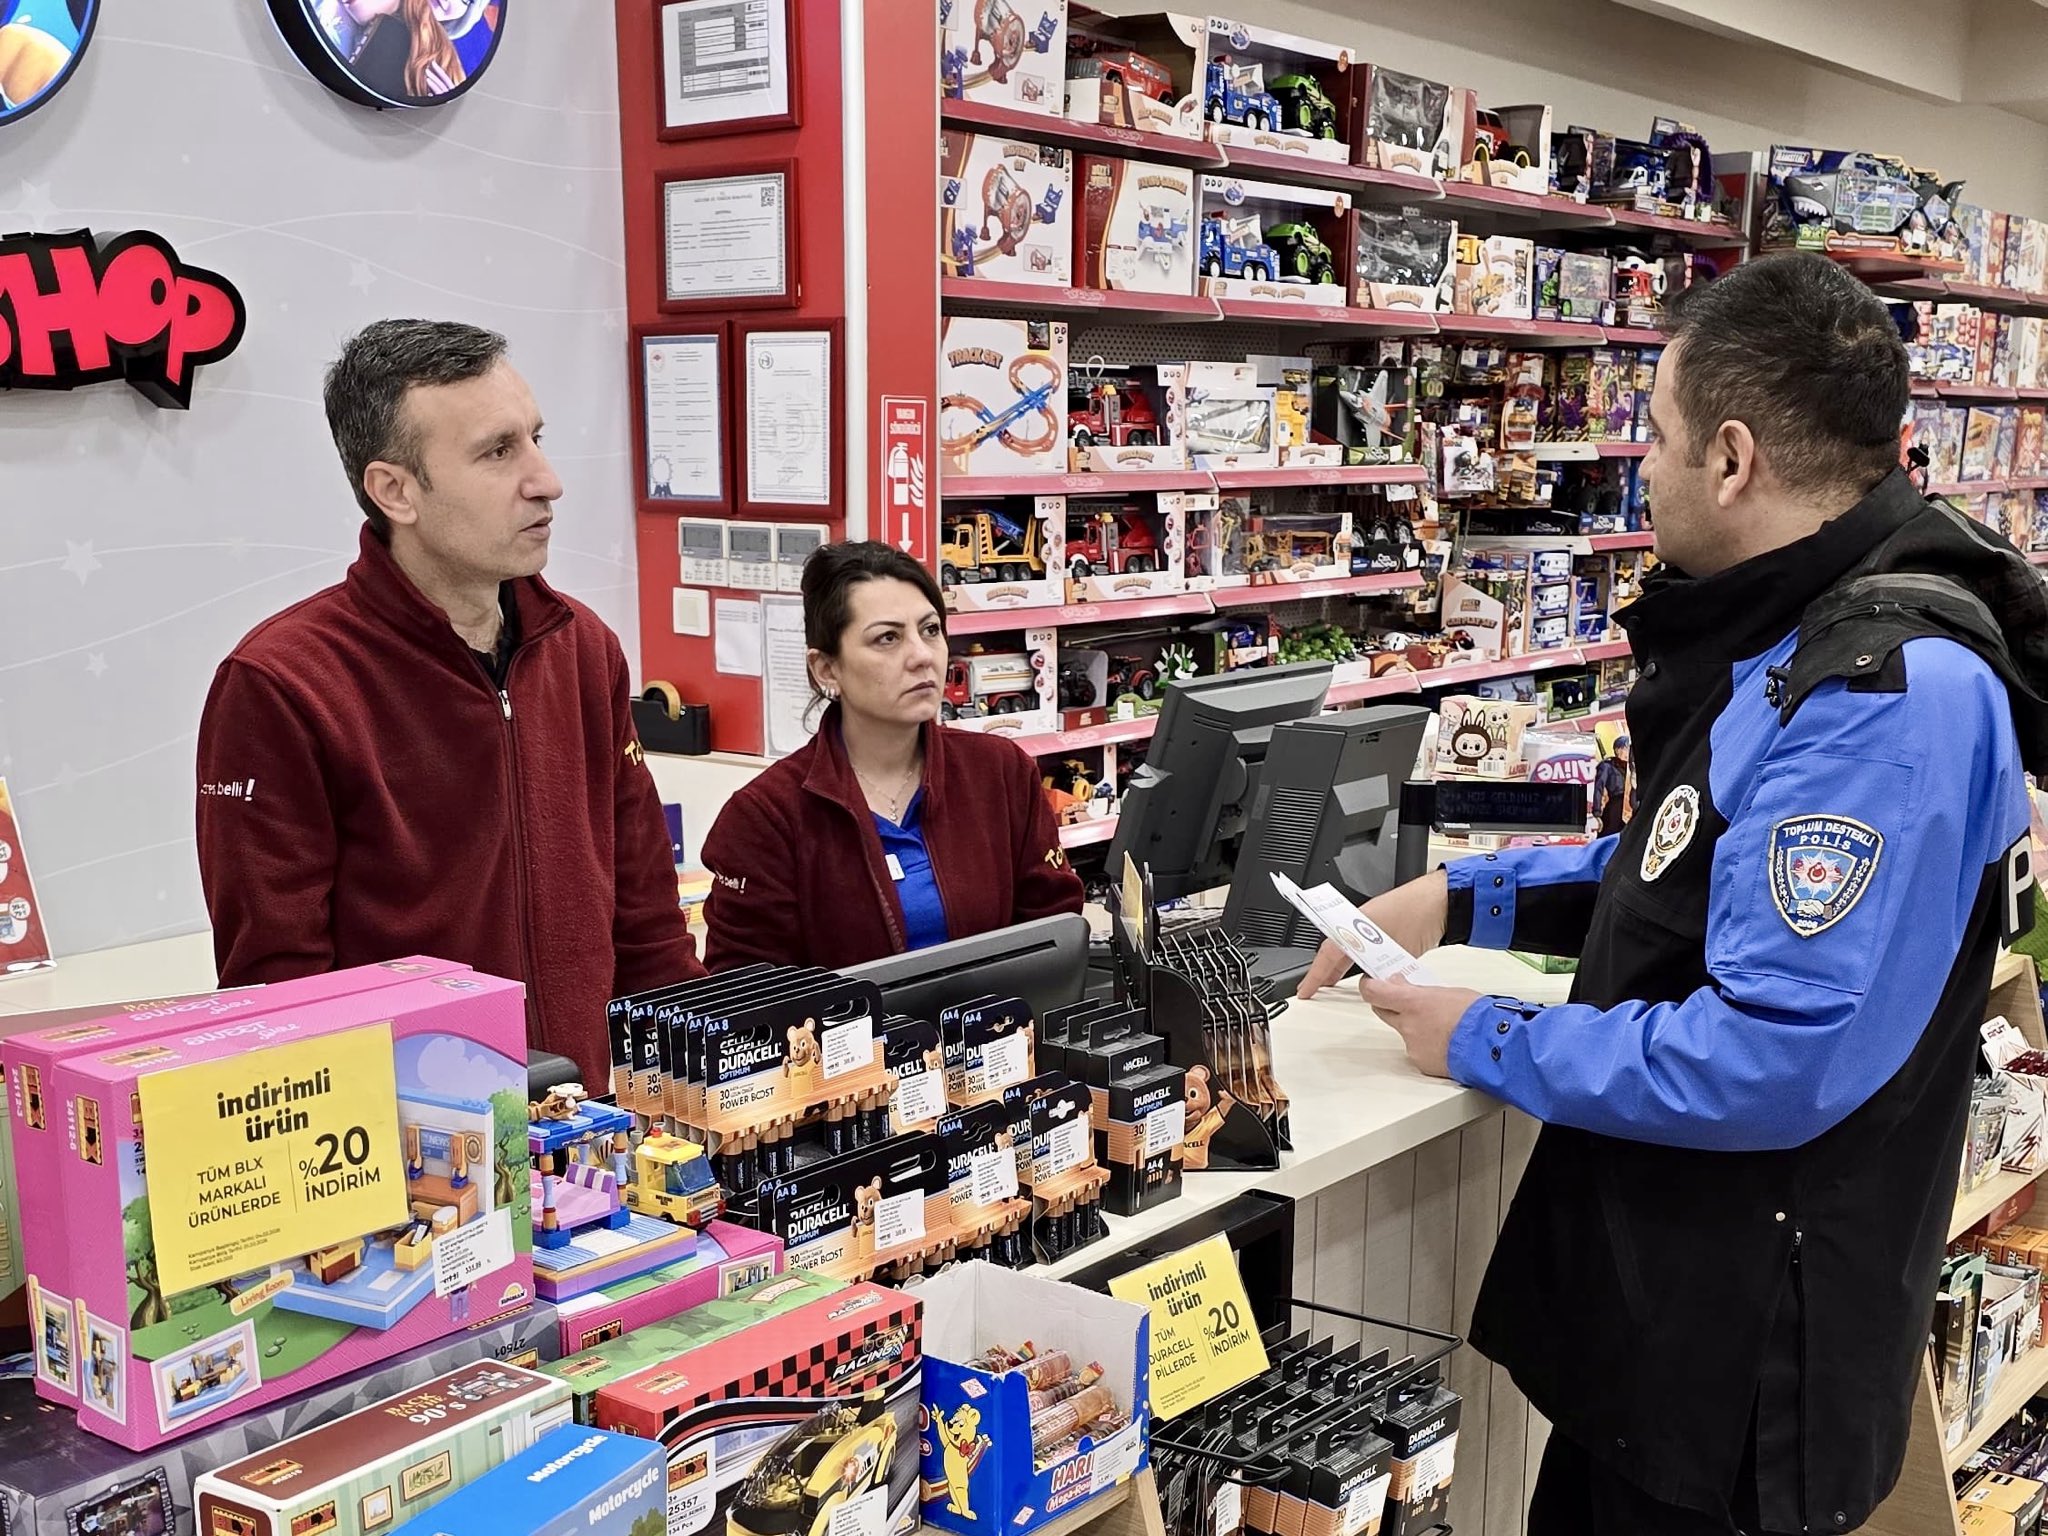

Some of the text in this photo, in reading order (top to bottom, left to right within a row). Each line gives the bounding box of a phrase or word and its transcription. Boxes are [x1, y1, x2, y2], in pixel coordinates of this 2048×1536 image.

[1783, 820, 1823, 838] TOPLUM
[2008, 835, 2034, 934] P
[609, 1003, 623, 1013] AA
[631, 1005, 653, 1018] AA 8
[658, 1008, 671, 1019] AA
[943, 1009, 960, 1021] AA 4
[965, 1012, 982, 1023] AA 4
[671, 1014, 686, 1026] AA
[689, 1018, 702, 1030] AA
[707, 1019, 729, 1033] AA 8
[719, 1042, 782, 1074] DURACELL
[719, 1066, 751, 1081] OPTIMUM
[217, 1067, 332, 1119] indirimli
[719, 1088, 730, 1101] 30
[968, 1082, 987, 1095] POWE
[1004, 1087, 1021, 1100] AA 4
[1133, 1086, 1171, 1108] DURACELL
[720, 1087, 775, 1111] POWER BOOST
[1032, 1099, 1048, 1112] AA 4
[1133, 1100, 1163, 1117] OPTIMUM
[245, 1107, 309, 1143] ürün
[941, 1120, 958, 1133] AAA
[1134, 1123, 1144, 1137] 30
[299, 1126, 371, 1180] %20
[1184, 1140, 1205, 1149] ACELL
[197, 1156, 264, 1185] TÜM BLX
[1147, 1157, 1164, 1171] AA 4
[305, 1166, 381, 1202] İNDİRİM
[760, 1181, 773, 1194] AA
[1034, 1171, 1051, 1184] POWE
[199, 1175, 267, 1206] MARKALI
[776, 1184, 797, 1199] AA 8
[950, 1190, 973, 1206] POWER
[188, 1191, 282, 1229] ÜRÜNLERDE
[788, 1203, 850, 1238] DURACELL
[789, 1229, 820, 1246] OPTIMUM
[790, 1253, 800, 1266] 30
[820, 1248, 844, 1264] BOOST
[1147, 1260, 1207, 1302] indirimli
[1167, 1290, 1203, 1318] ürün
[1204, 1300, 1241, 1342] %20
[1155, 1326, 1176, 1344] TÜM
[1210, 1329, 1251, 1358] İNDİRİM
[495, 1337, 527, 1358] 27501
[1149, 1337, 1195, 1366] DURACELL
[832, 1345, 893, 1380] RACING
[1155, 1351, 1198, 1381] PİLLERDE
[384, 1392, 436, 1417] BACK
[1408, 1417, 1447, 1446] DURACELL
[1408, 1433, 1437, 1453] OPTIMUM
[527, 1435, 608, 1482] Motorcycle
[1051, 1452, 1095, 1492] HARI
[1340, 1464, 1378, 1494] DURACELL
[588, 1467, 659, 1526] Motorcycle
[667, 1495, 699, 1516] 25357
